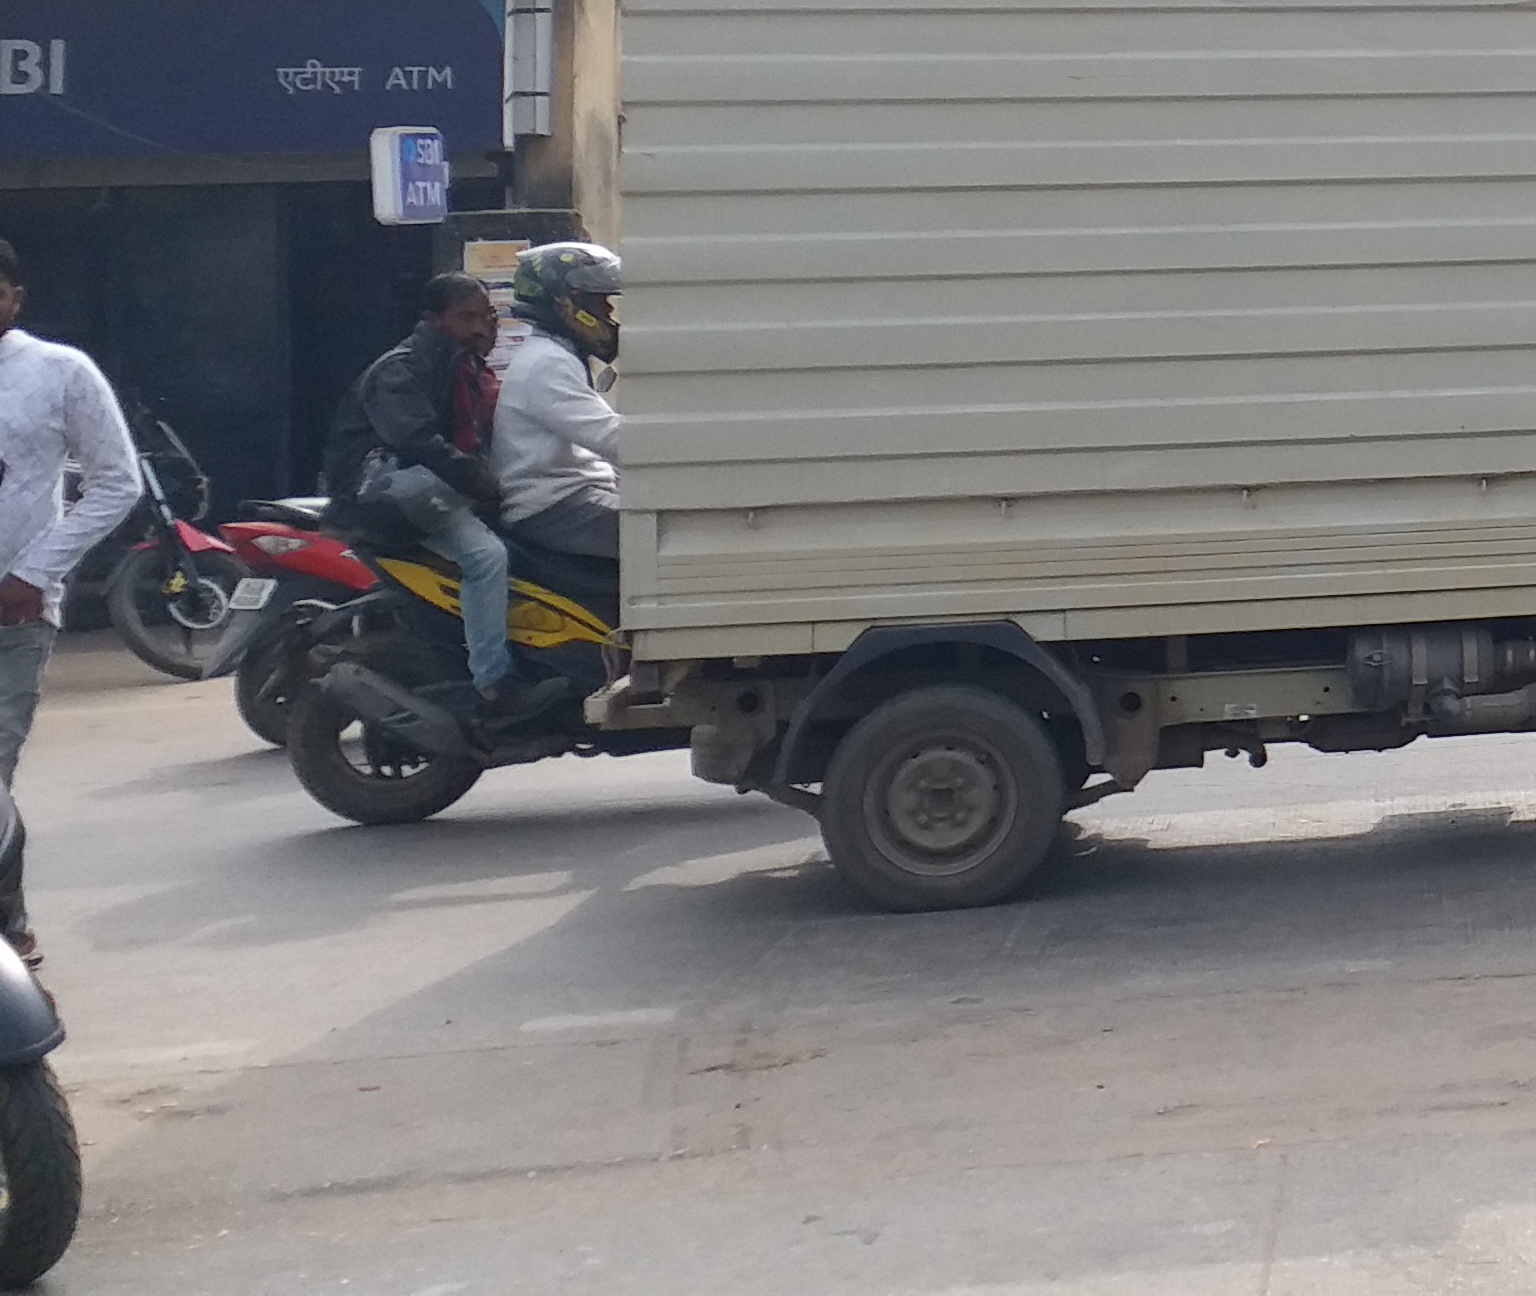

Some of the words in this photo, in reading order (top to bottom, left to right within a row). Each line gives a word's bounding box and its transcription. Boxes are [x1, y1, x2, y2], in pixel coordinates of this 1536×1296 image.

[275, 59, 364, 95] एटीएम
[385, 65, 452, 90] ATM
[416, 138, 442, 165] SBI
[406, 181, 441, 206] ATM
